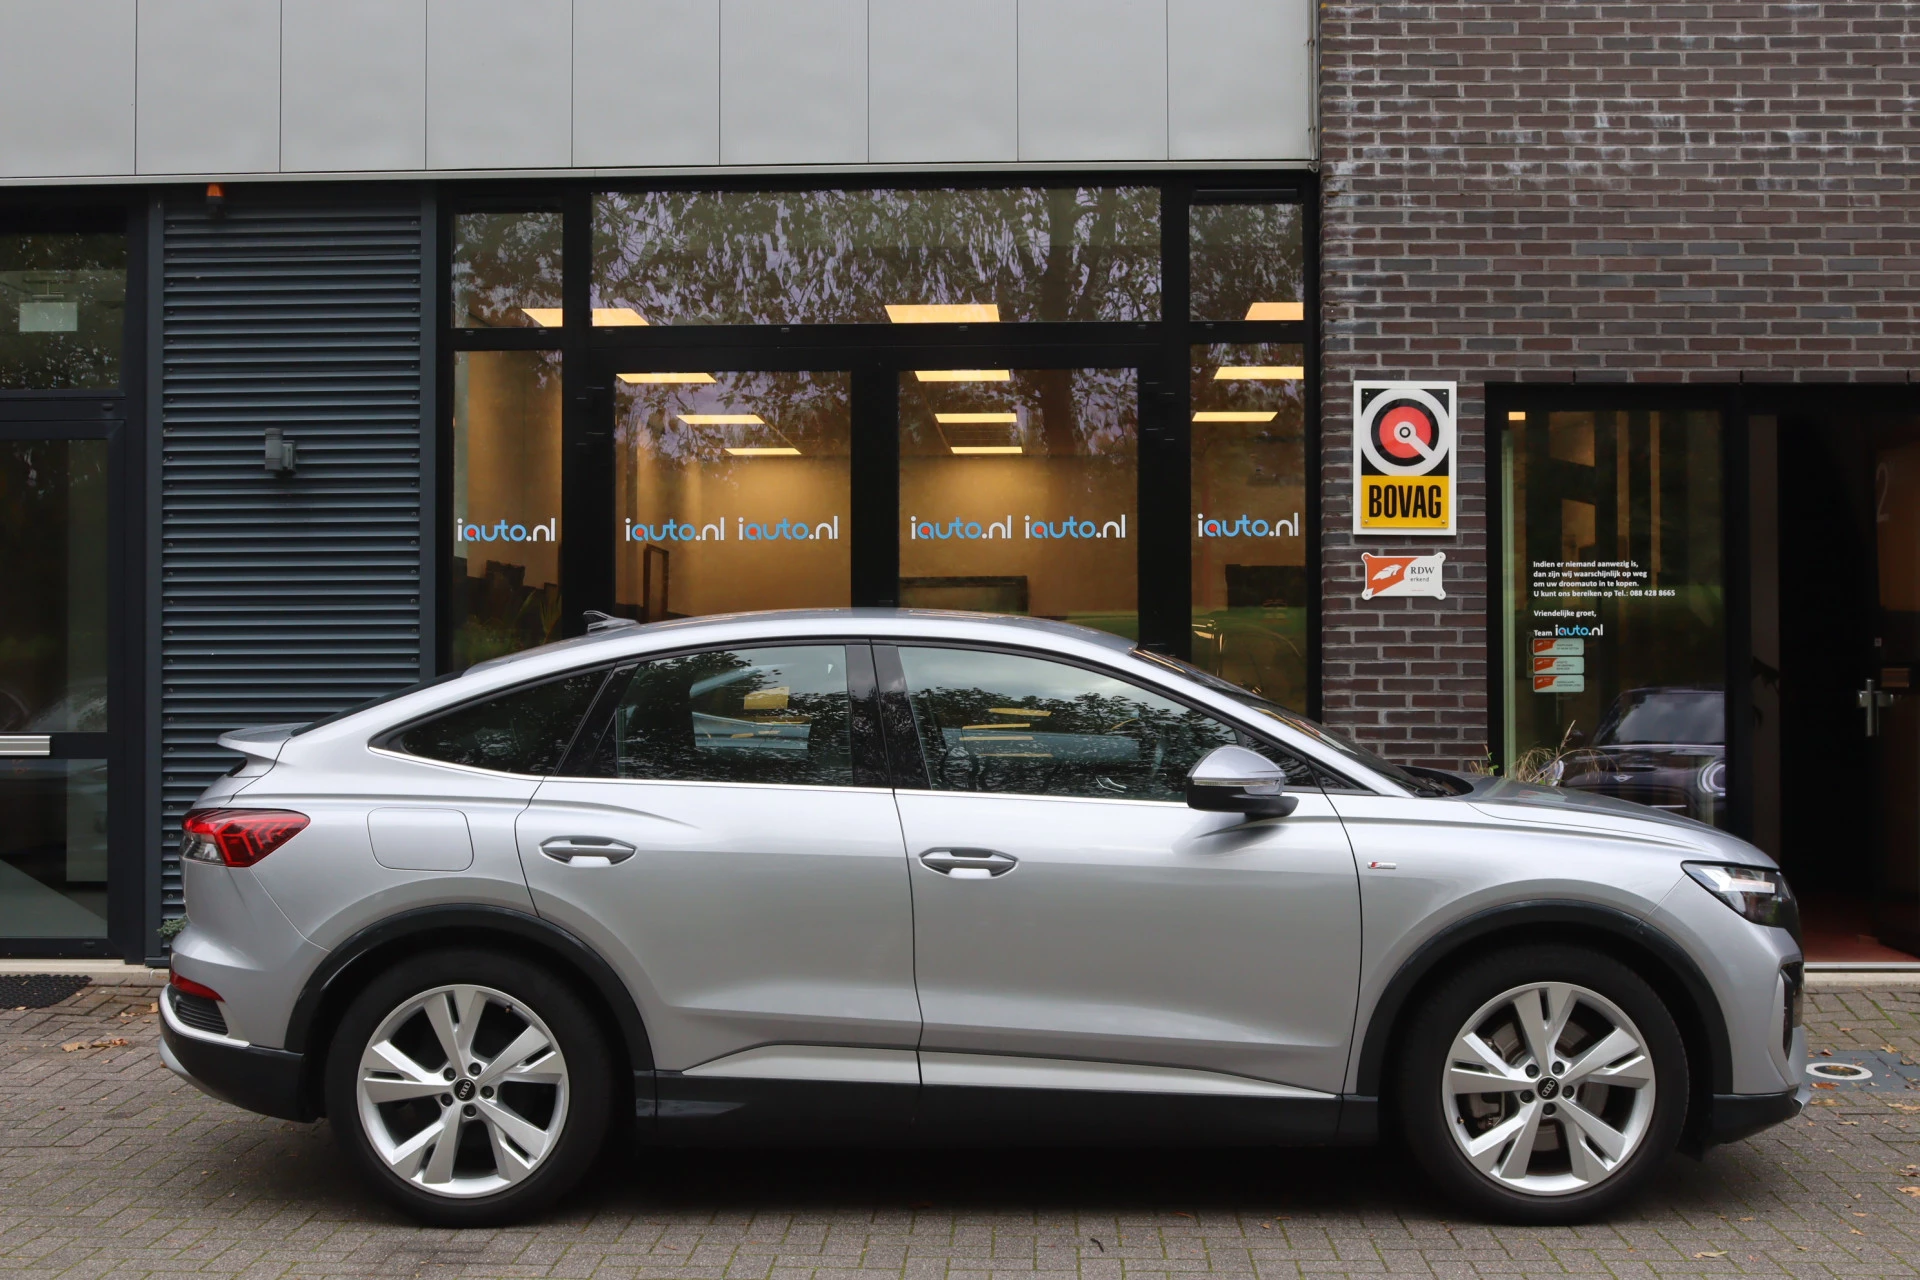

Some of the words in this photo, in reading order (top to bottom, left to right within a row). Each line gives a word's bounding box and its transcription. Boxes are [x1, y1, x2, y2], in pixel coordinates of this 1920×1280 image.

[1368, 484, 1442, 519] BOVAG
[457, 517, 556, 542] iauto.nl
[625, 516, 725, 542] iauto.nl
[738, 515, 839, 541] iauto.nl
[911, 514, 1012, 540] iauto.nl
[1024, 513, 1126, 539] iauto.nl
[1197, 512, 1299, 537] iauto.nl
[1410, 566, 1435, 575] RDW
[1598, 560, 1629, 568] aanwezig
[1555, 624, 1603, 636] iauto.nl
